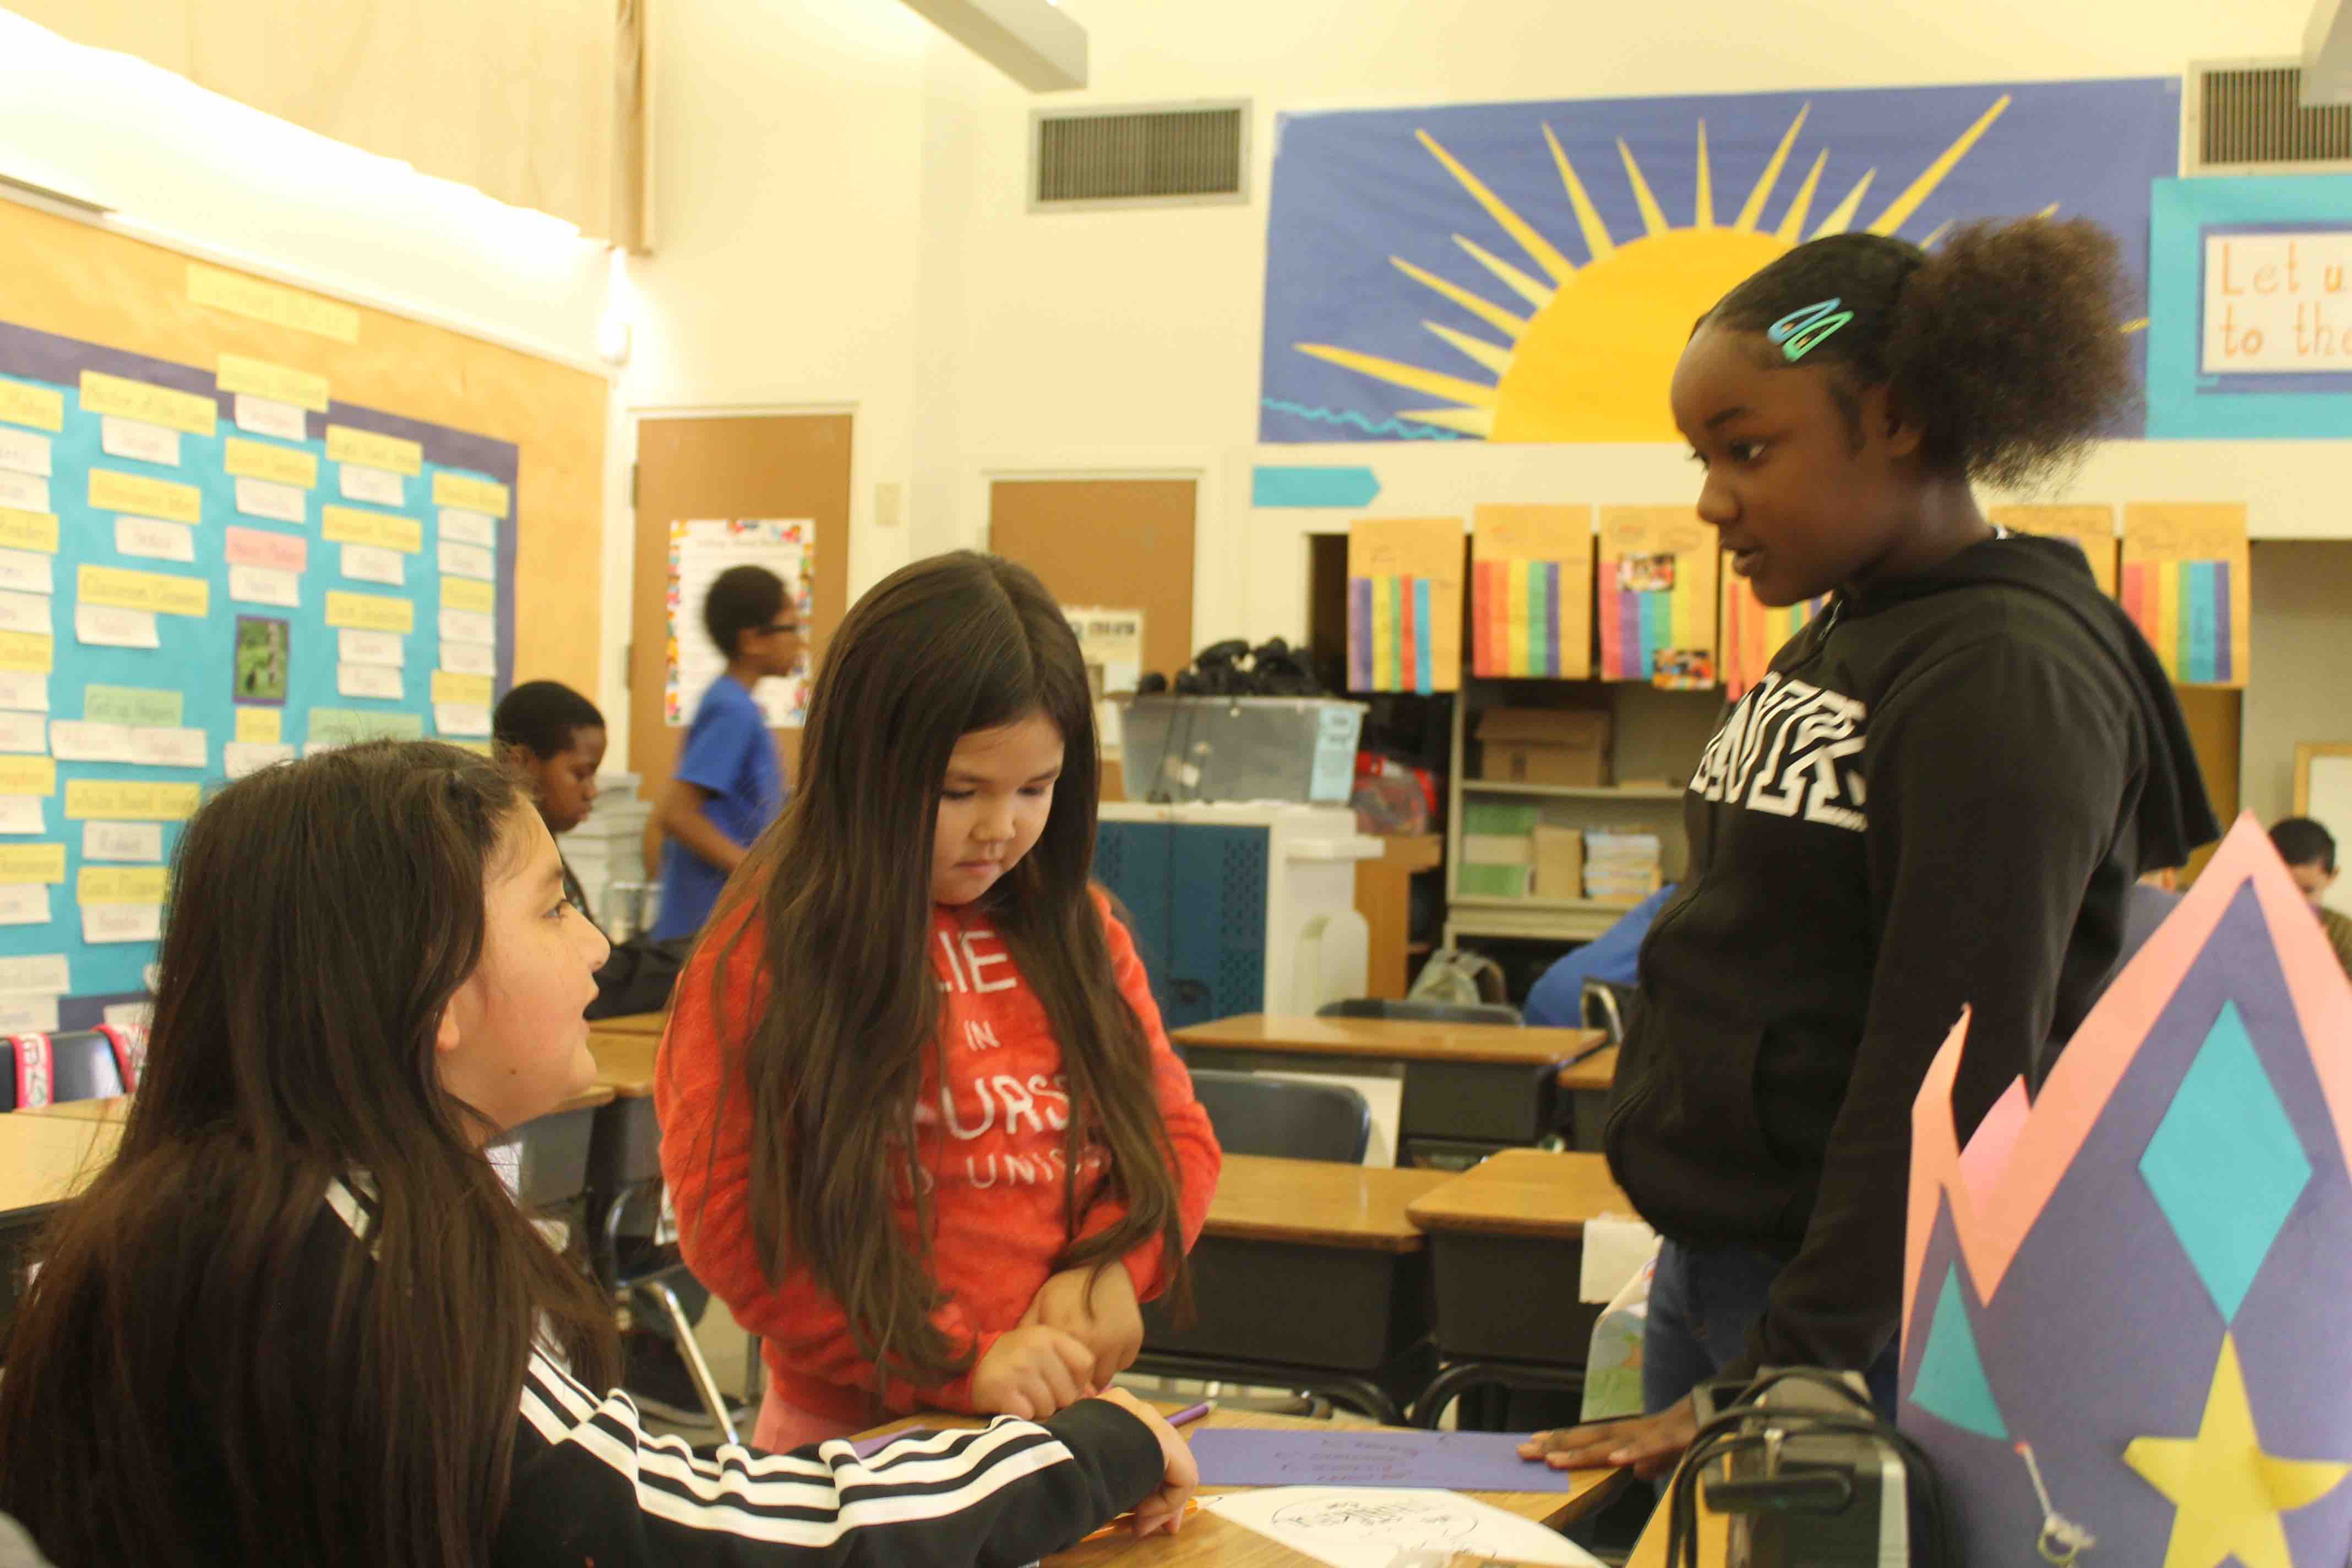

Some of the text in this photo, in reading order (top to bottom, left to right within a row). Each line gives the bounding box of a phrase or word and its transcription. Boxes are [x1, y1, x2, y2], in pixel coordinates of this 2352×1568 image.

[2221, 239, 2300, 295] Let
[2220, 301, 2264, 359] to
[965, 1020, 1000, 1052] IN
